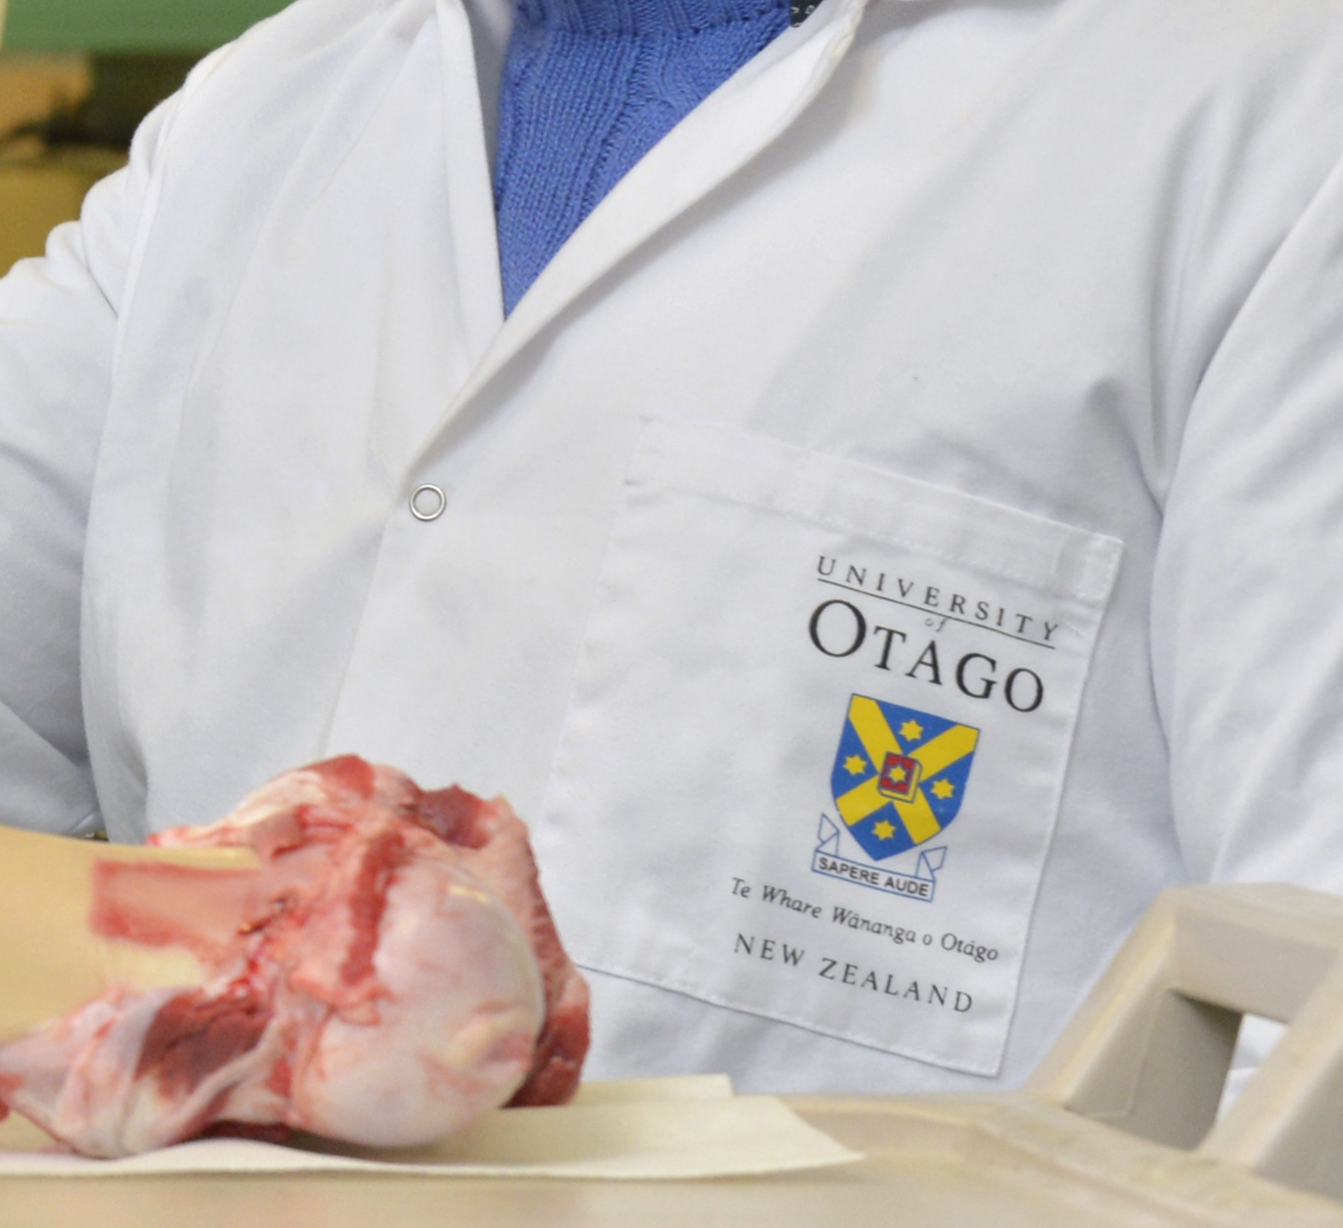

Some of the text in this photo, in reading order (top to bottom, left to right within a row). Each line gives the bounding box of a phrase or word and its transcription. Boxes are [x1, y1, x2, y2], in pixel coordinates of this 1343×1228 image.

[816, 555, 1059, 642] UNIVERSITY
[924, 617, 949, 633] of
[808, 599, 1044, 713] OTAGO
[731, 877, 751, 898] Te
[762, 885, 823, 919] Whare
[922, 935, 933, 946] o
[818, 857, 929, 897] SAPERE AUDE
[734, 933, 974, 1013] NEW ZEALAND
